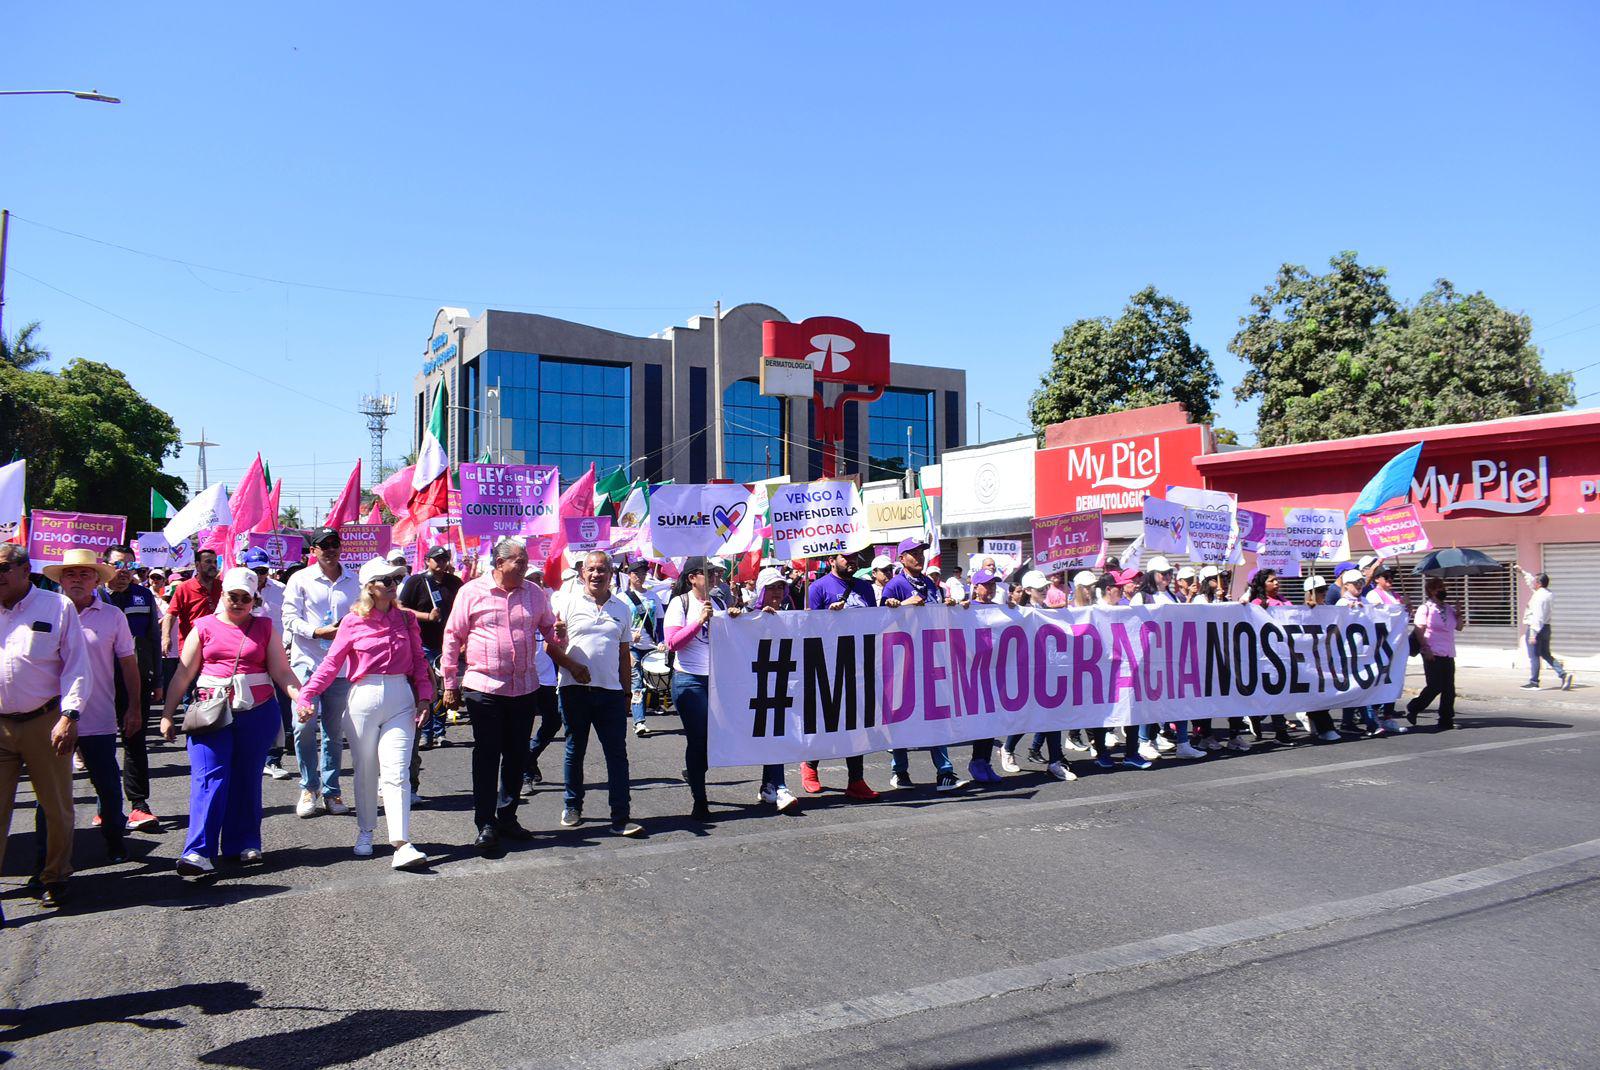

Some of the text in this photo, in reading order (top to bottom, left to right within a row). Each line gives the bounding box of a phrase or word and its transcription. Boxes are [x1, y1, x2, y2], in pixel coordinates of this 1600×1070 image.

[765, 360, 813, 370] DERMATOLOGICA
[1067, 436, 1161, 487] My Piel
[477, 467, 505, 482] LEY
[525, 470, 551, 485] LEY
[1471, 455, 1549, 500] Piel
[478, 484, 543, 497] RESPETO
[785, 490, 844, 504] VENGO A
[1075, 489, 1151, 512] DERMATOLOGIC
[466, 501, 554, 516] CONSTITUCIÓN
[774, 506, 859, 522] DENFENDER LA
[41, 517, 114, 532] Por nuestra
[1295, 514, 1335, 524] VENGO A
[33, 531, 119, 546] DEMOCRACIA
[1286, 527, 1332, 535] DENFENDER
[1334, 528, 1344, 536] LA
[989, 542, 1017, 552] VOTO
[1047, 531, 1089, 548] LA LEY.
[748, 621, 1394, 738] #MIDEMOCRACIANOSETOCA
